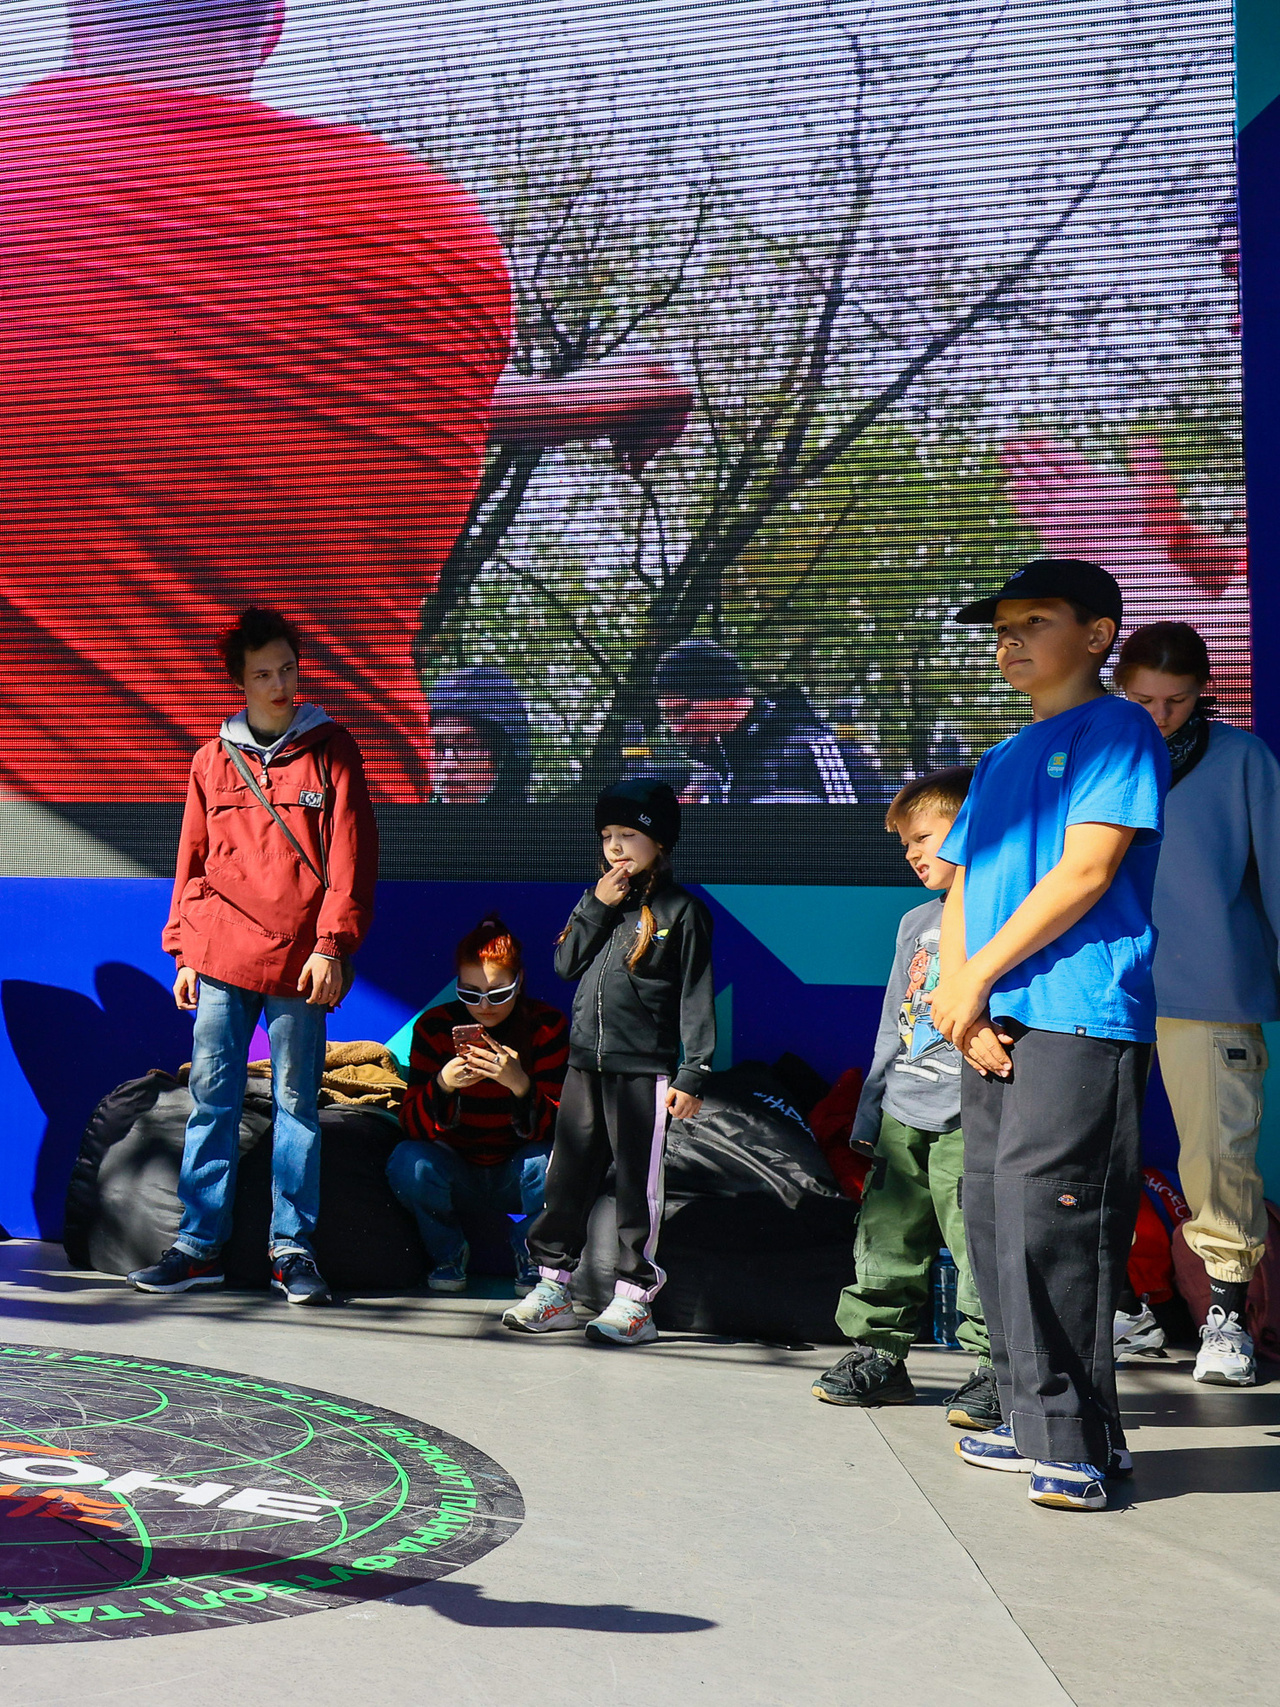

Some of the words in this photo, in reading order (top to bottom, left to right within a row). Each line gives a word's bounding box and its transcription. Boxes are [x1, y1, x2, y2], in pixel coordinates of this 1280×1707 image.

[70, 1355, 374, 1423] ЕДИНОБОРСТВА
[378, 1428, 476, 1489] ВОРКАУТ
[381, 1494, 477, 1553] ПАННА
[173, 1555, 399, 1610] ФУТБОЛ
